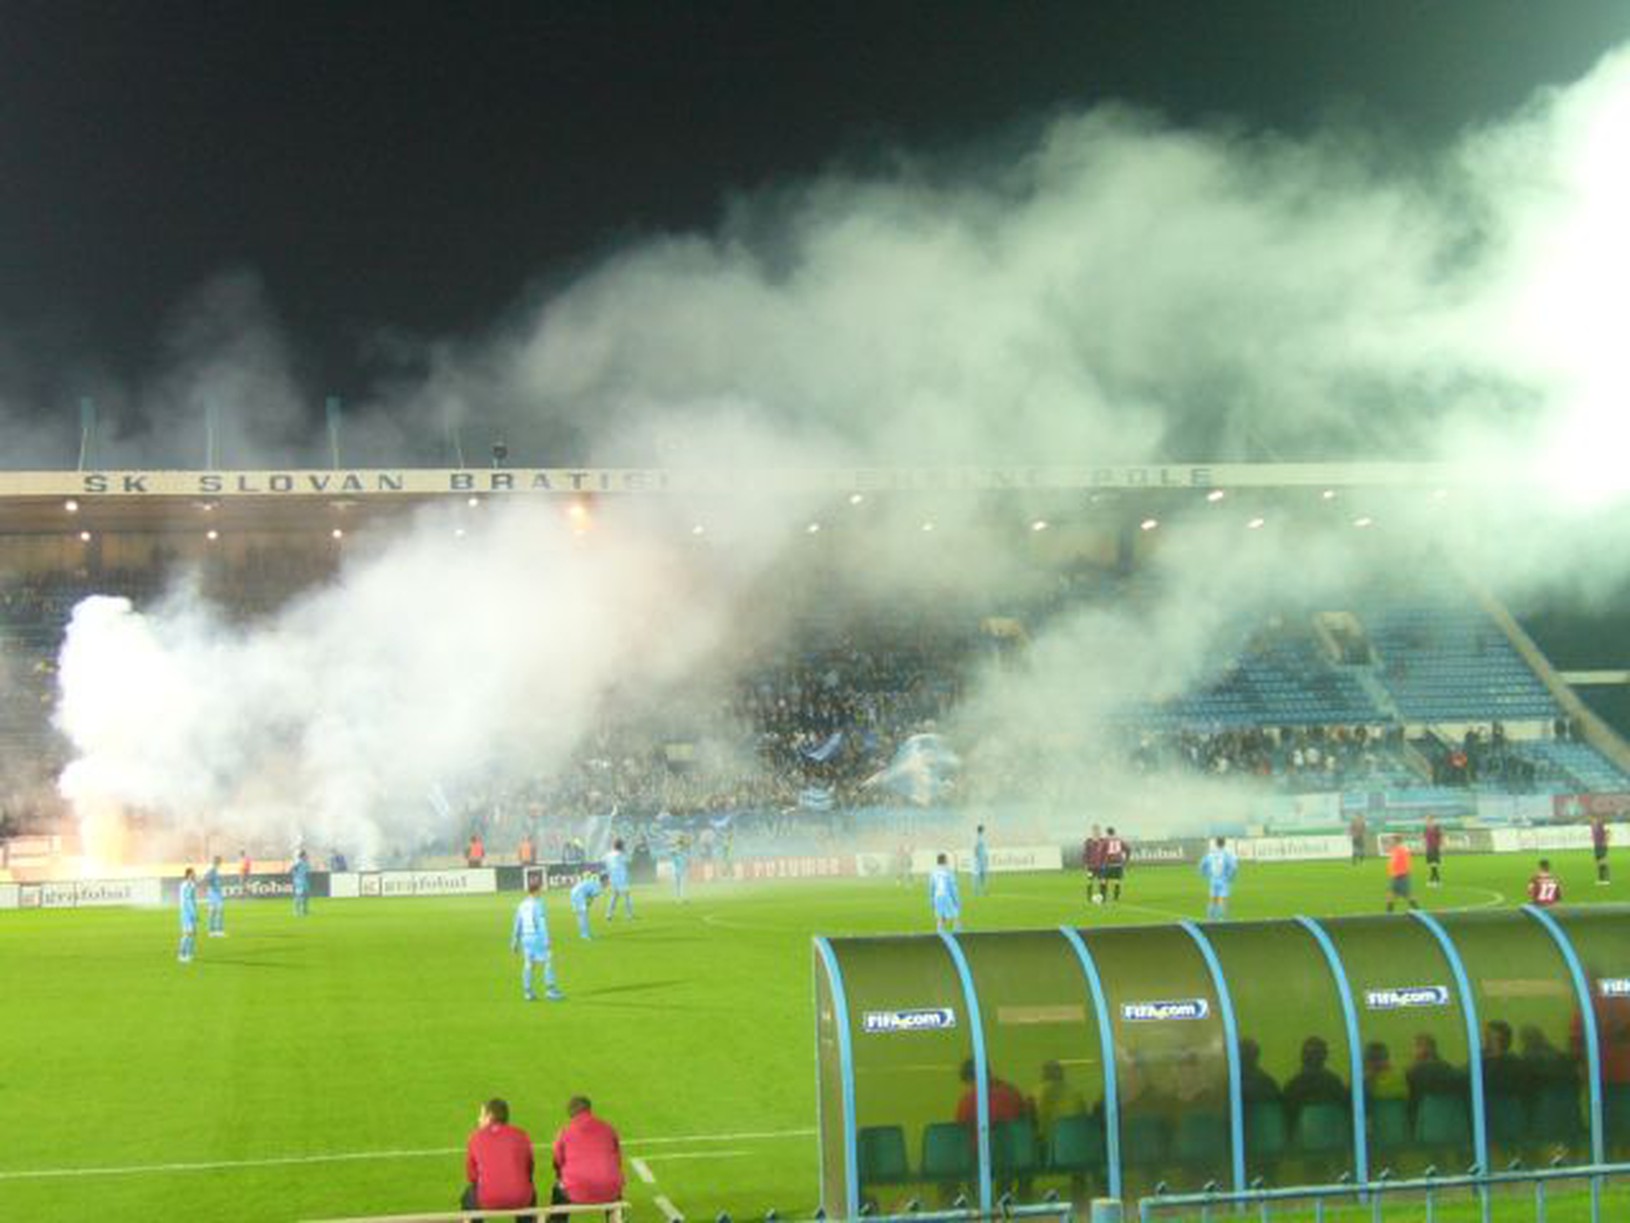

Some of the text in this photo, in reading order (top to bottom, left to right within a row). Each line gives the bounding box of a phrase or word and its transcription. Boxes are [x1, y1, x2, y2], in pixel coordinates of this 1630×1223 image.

[84, 475, 148, 492] SK
[199, 474, 403, 491] SLOVAN
[1124, 1002, 1196, 1019] FIFA.com
[867, 1012, 941, 1029] FIFA.com
